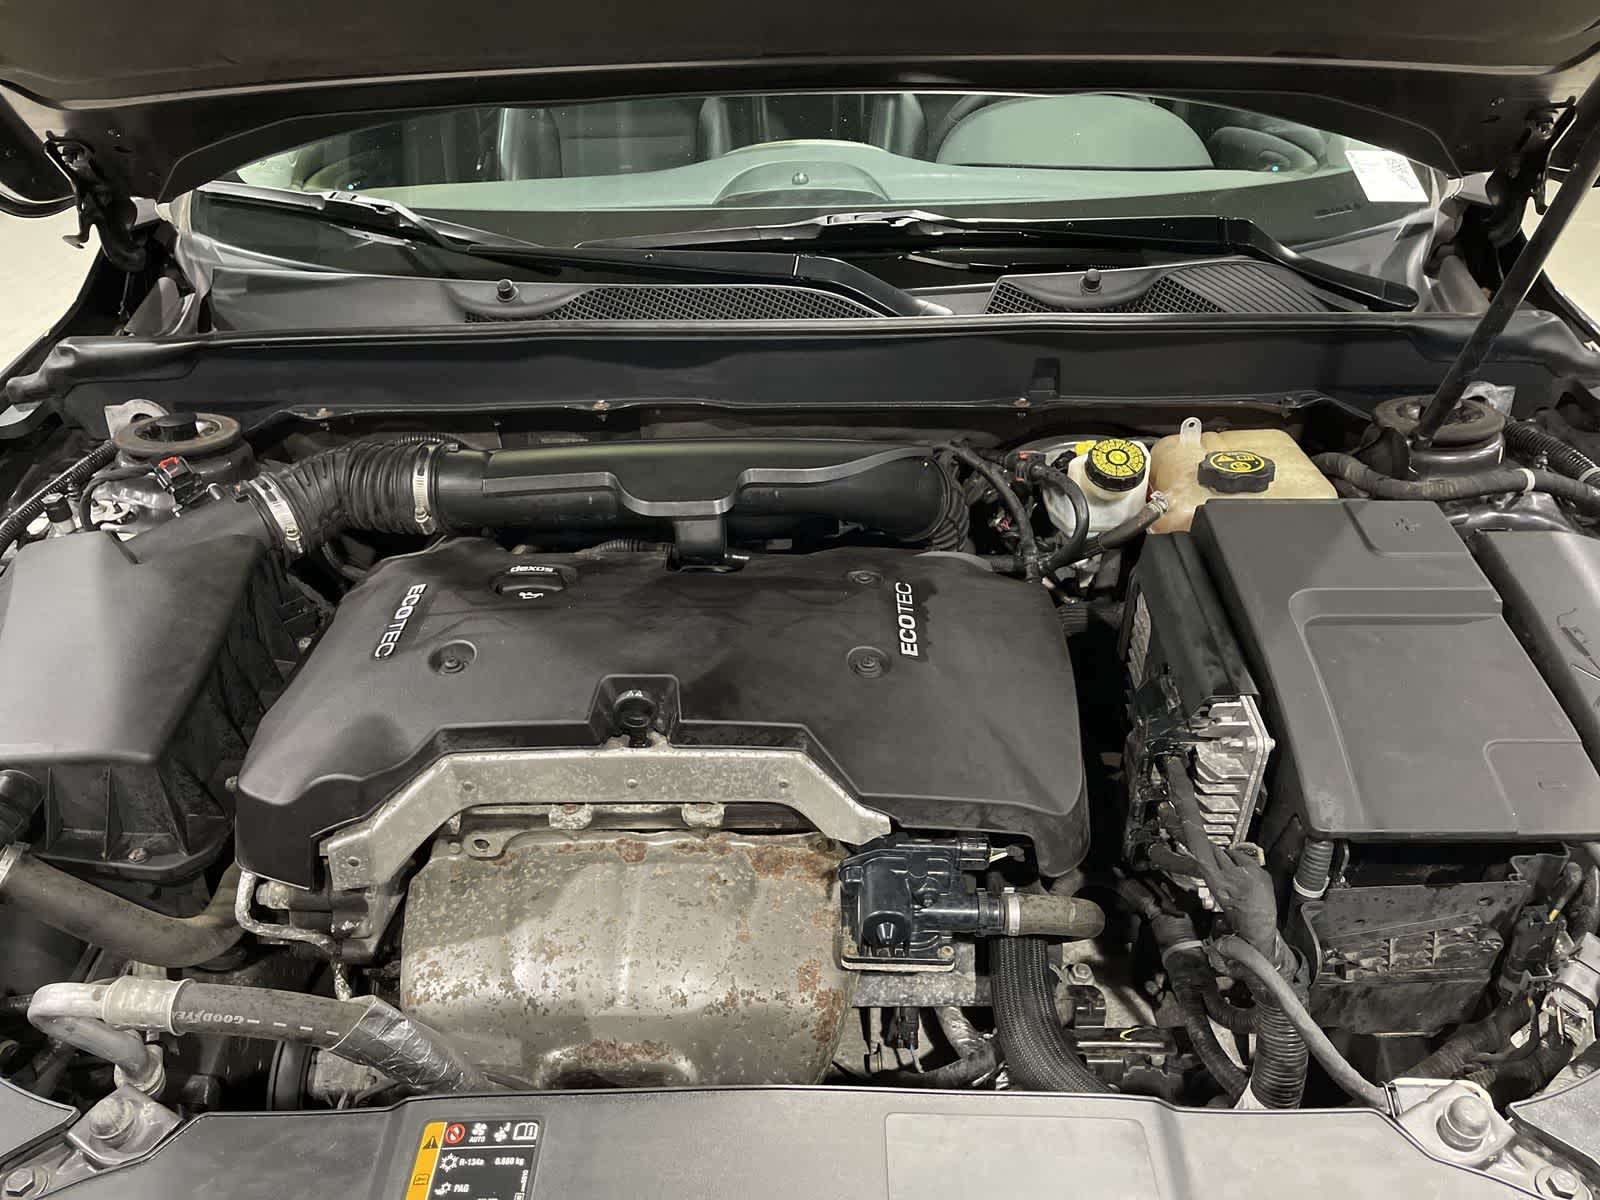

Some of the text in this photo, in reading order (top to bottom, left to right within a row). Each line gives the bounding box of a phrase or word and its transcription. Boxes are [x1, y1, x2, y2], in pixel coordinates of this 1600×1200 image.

[510, 565, 554, 573] dexos
[375, 583, 428, 659] ECOTEC
[895, 582, 919, 657] ECOTEC
[173, 1010, 244, 1024] GOODYE
